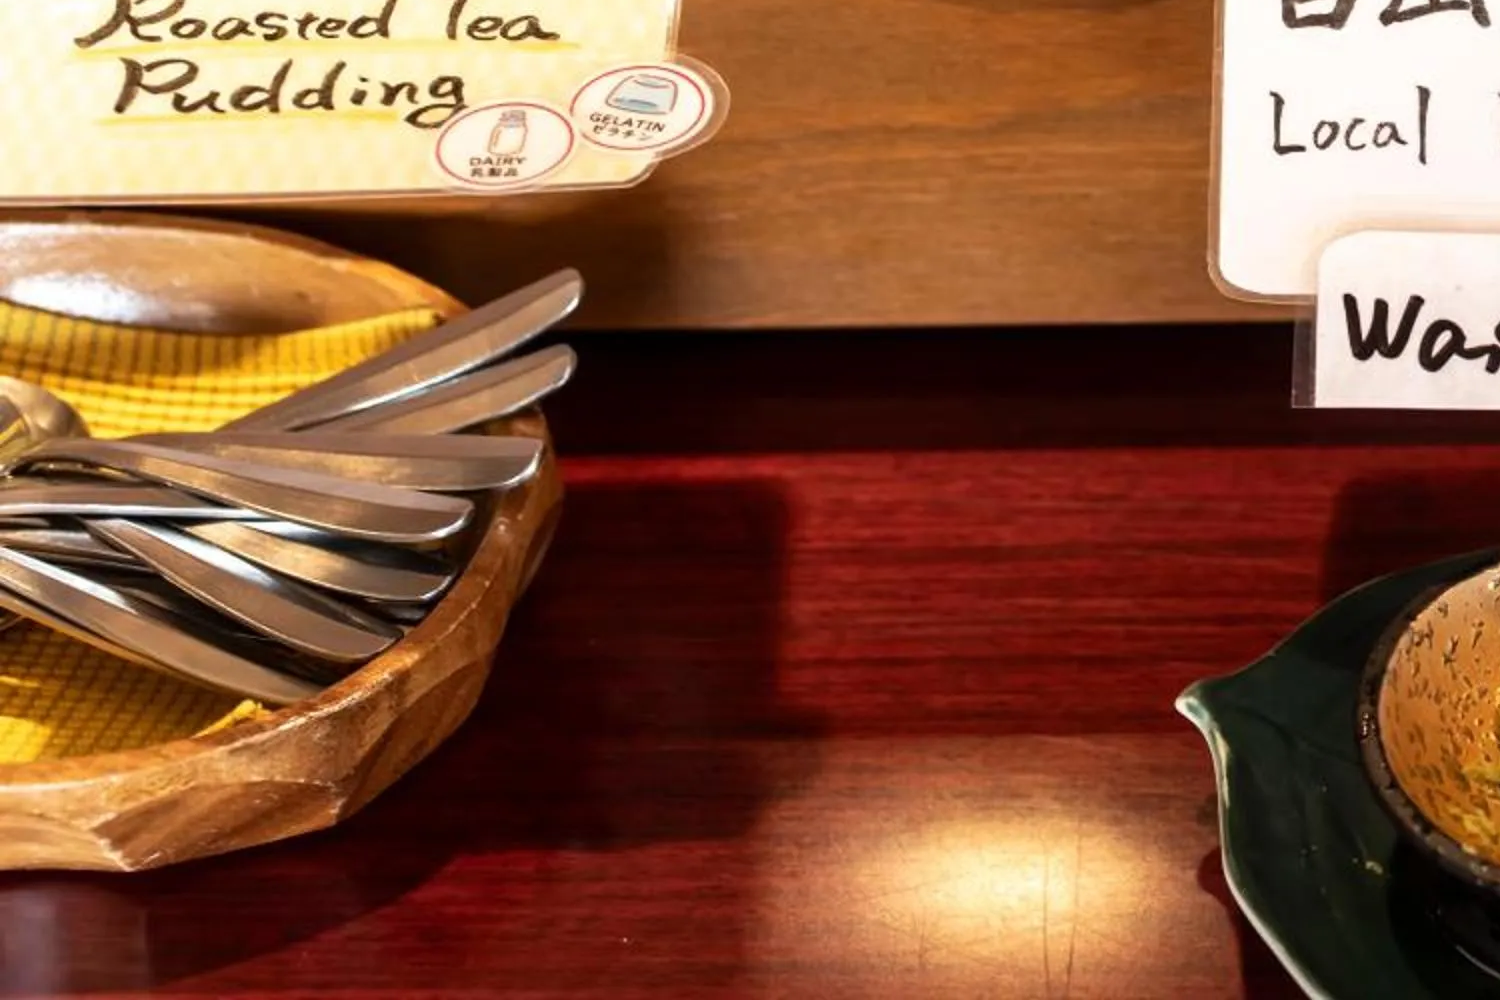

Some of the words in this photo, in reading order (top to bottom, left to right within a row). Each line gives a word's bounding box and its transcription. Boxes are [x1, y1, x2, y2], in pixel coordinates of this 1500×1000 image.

[112, 58, 468, 130] Pudding
[589, 111, 667, 134] GELATIN
[1269, 85, 1430, 164] Local
[469, 155, 526, 168] DAIRY
